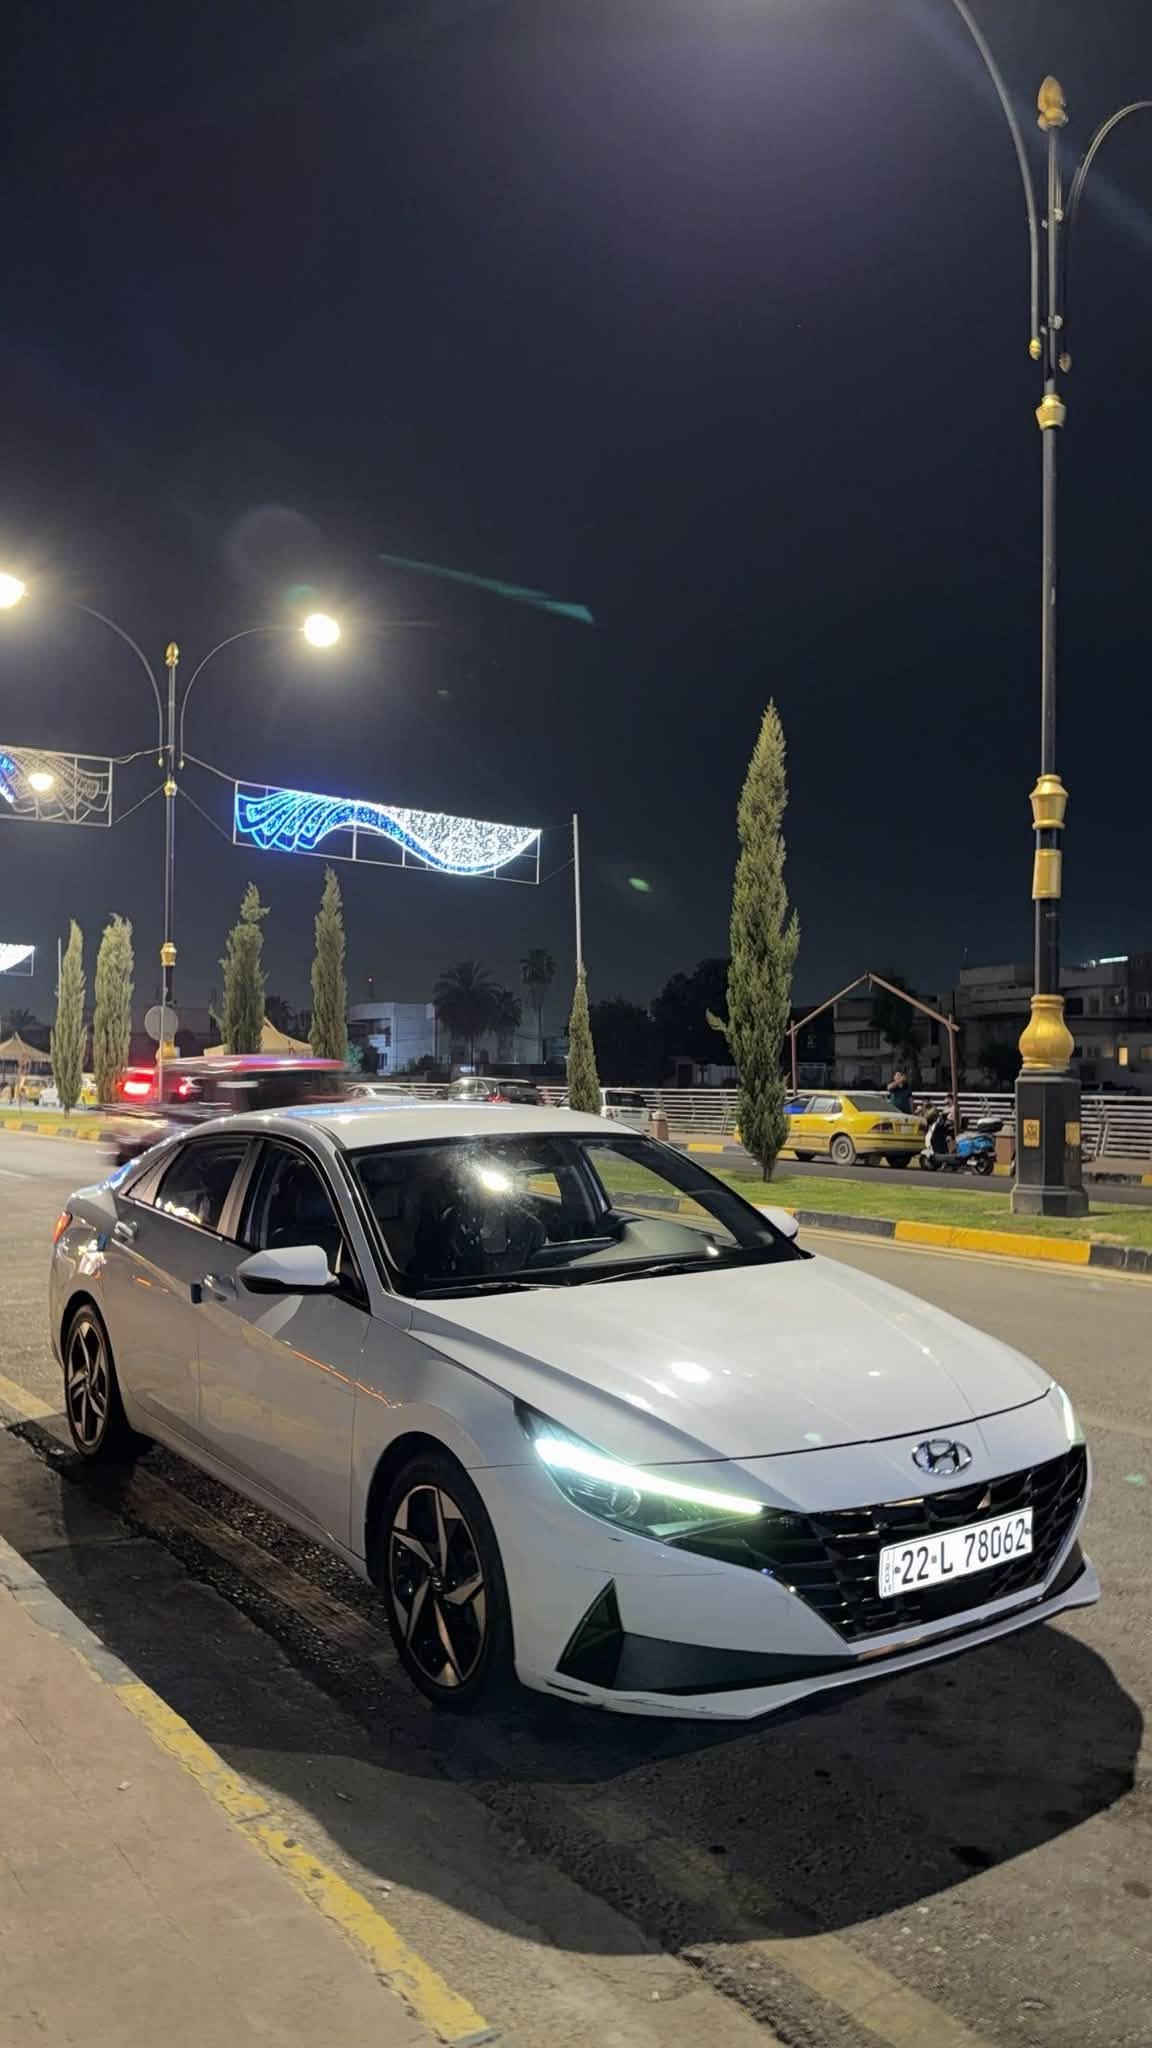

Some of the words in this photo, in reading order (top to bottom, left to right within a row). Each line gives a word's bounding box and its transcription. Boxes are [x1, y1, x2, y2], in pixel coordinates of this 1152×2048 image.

[901, 1546, 929, 1585] 22
[940, 1541, 953, 1574] L
[964, 1518, 1026, 1568] 78062
